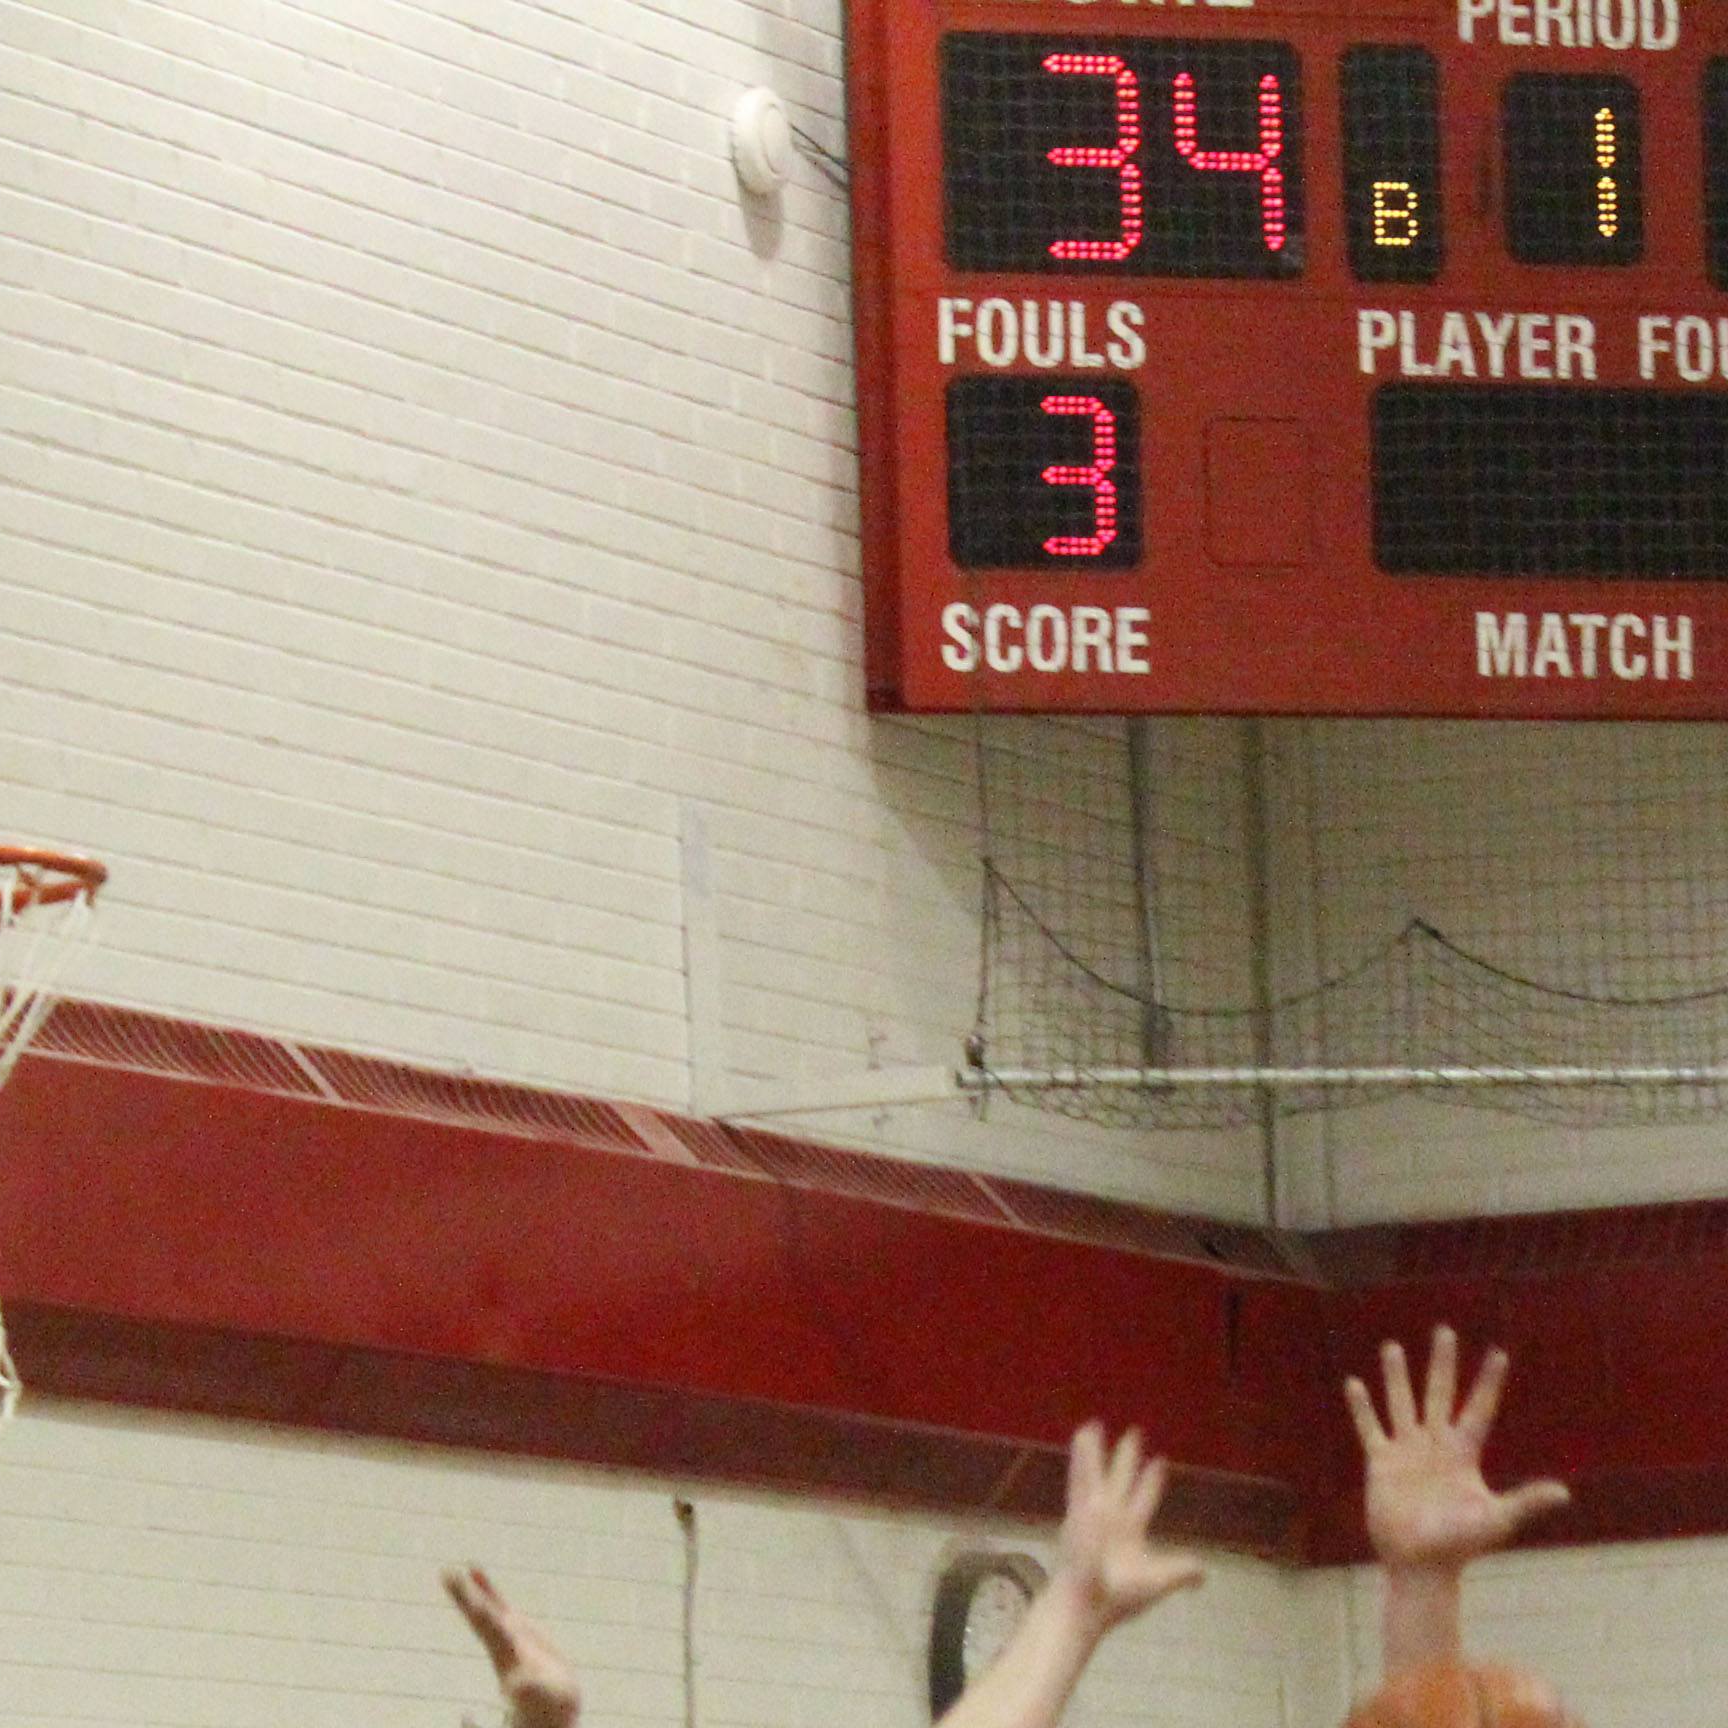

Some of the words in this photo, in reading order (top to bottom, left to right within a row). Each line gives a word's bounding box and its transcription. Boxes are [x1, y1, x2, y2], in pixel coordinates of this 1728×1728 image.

[1457, 0, 1680, 50] PERIOD
[1042, 53, 1285, 262] 34
[1594, 107, 1618, 237] 1
[937, 297, 1146, 369] FOULS
[1358, 309, 1596, 382] PLAYER
[1039, 395, 1117, 556] 3
[940, 602, 1151, 674] SCORE
[1474, 612, 1695, 681] MATCH
